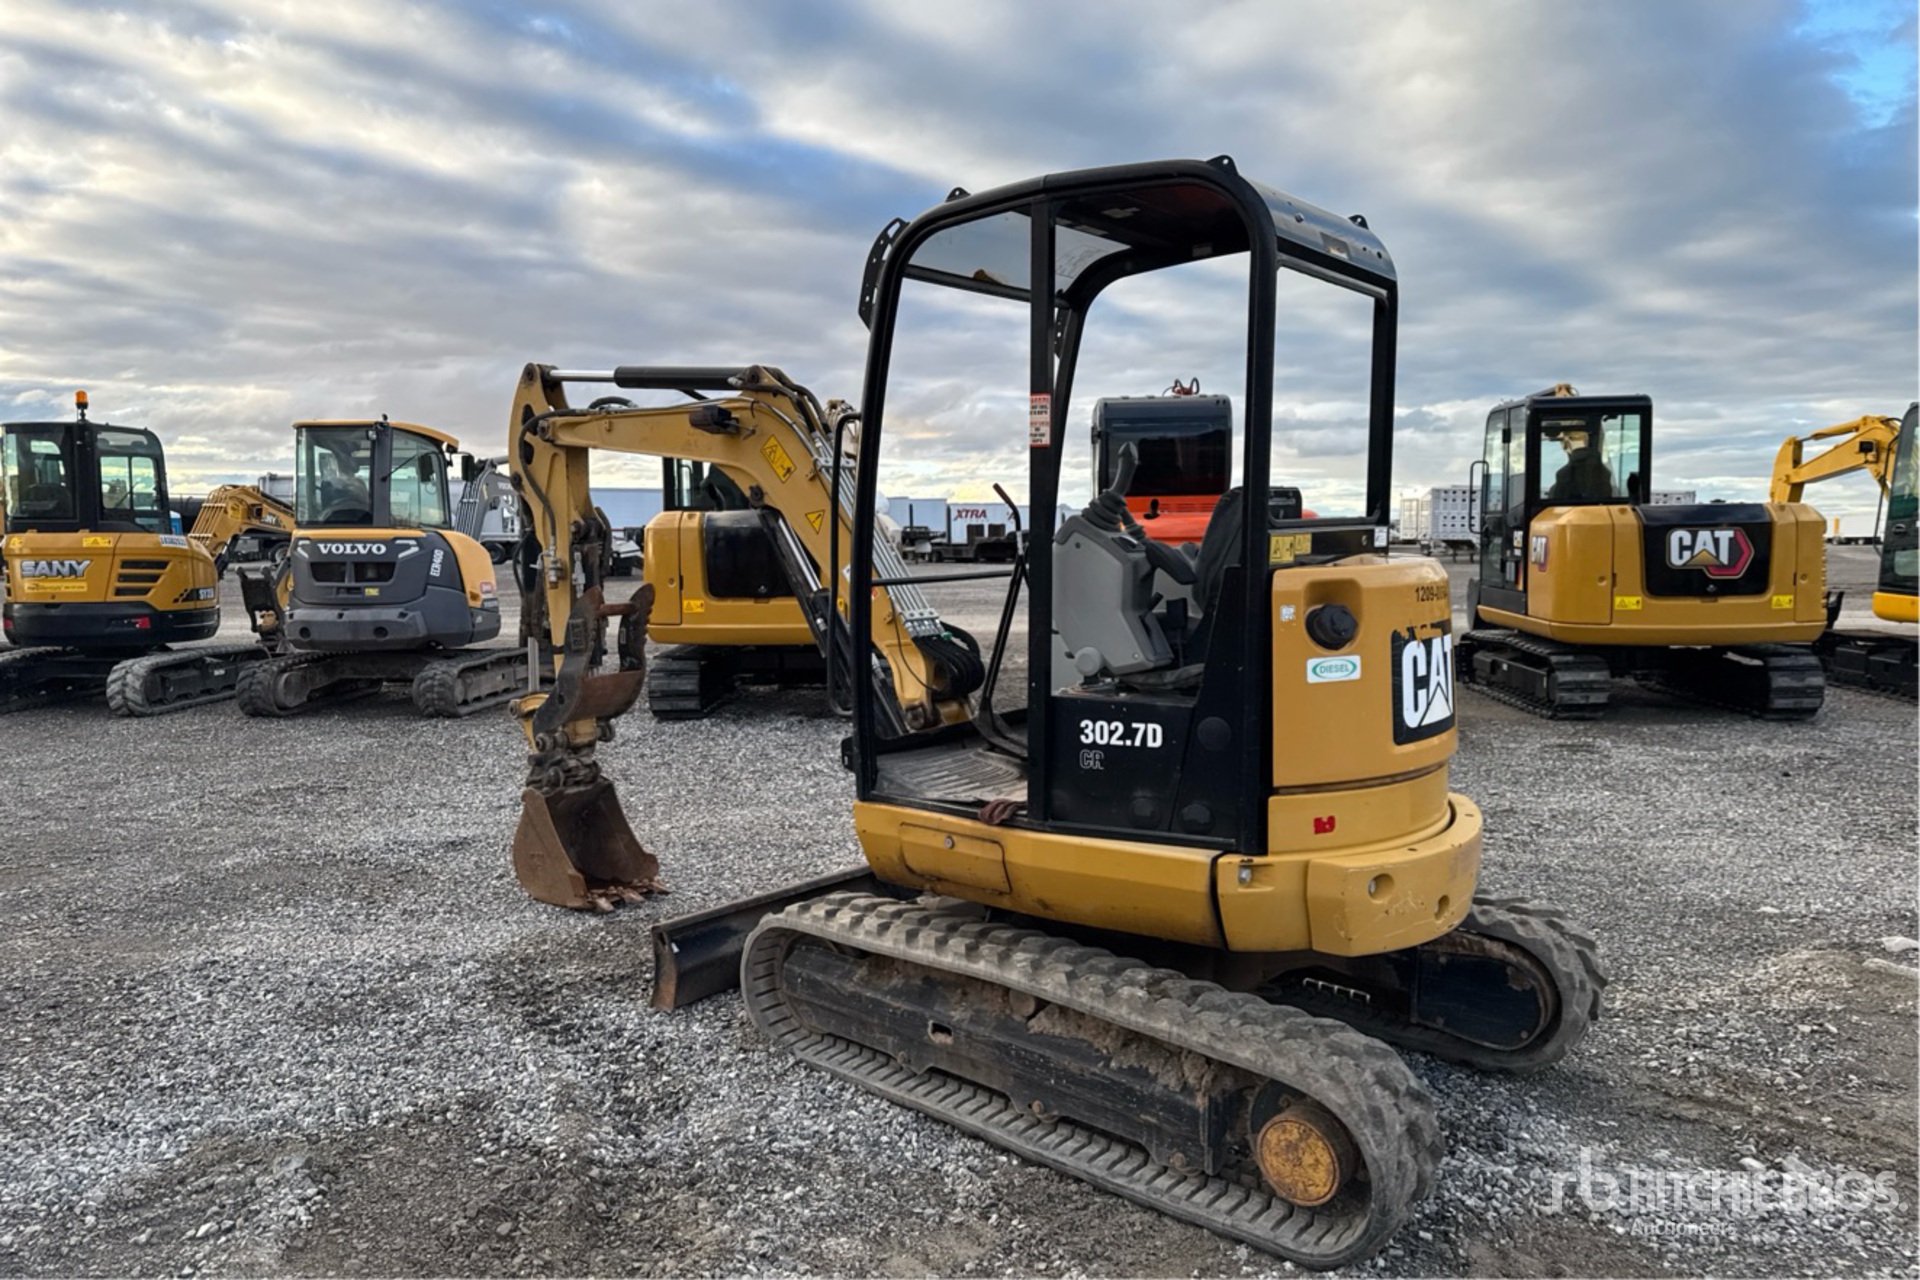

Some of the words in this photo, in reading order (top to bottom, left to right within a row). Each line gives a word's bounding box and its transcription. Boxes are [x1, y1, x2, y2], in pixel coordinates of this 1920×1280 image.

[953, 508, 987, 521] XTRA
[317, 543, 387, 554] VOLVO
[1531, 536, 1547, 563] CAT
[1669, 530, 1734, 566] CAT
[21, 560, 91, 577] SANY
[1319, 664, 1350, 674] DIESEL
[1402, 633, 1454, 729] CAT
[1079, 719, 1163, 748] 302.7D
[1079, 749, 1104, 769] CR
